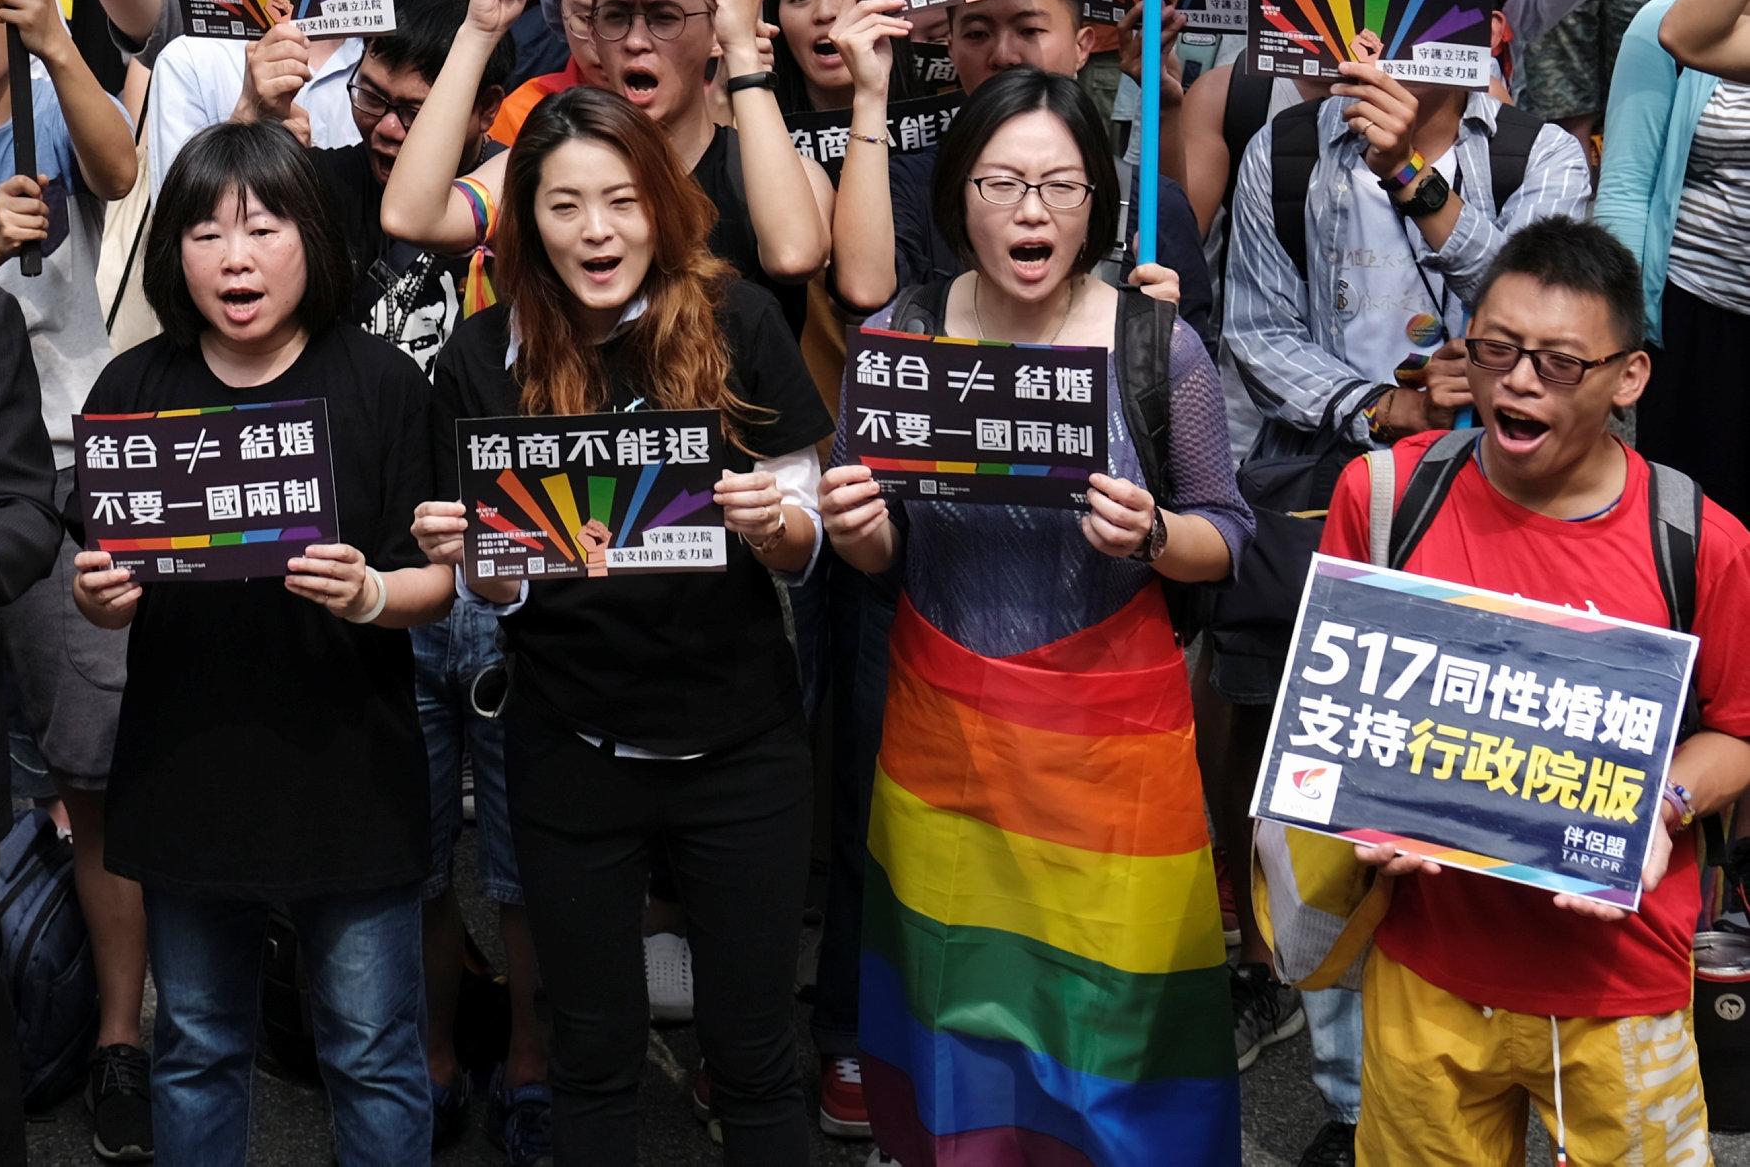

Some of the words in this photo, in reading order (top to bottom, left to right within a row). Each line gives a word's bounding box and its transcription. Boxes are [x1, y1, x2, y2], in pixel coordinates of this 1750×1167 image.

[326, 0, 383, 14] 守護立法院
[1382, 63, 1478, 81] 給支持的立委力量
[1418, 47, 1479, 63] 守護立法院
[855, 349, 931, 392] 結合
[1013, 364, 1094, 404] 結婚
[84, 434, 157, 471] 結合
[239, 420, 315, 461] 結婚
[467, 427, 710, 471] 協商不能退
[856, 407, 1094, 458] 不要一國兩制
[91, 476, 321, 527] 不要一國兩制
[611, 548, 715, 564] 給支持的立委力量
[649, 530, 713, 545] 守護立法院
[1301, 621, 1662, 755] 517同性婚姻
[1290, 694, 1645, 824] 支持行政院版
[1561, 849, 1622, 873] TAPCPR
[1563, 824, 1627, 860] 伴侶盟
